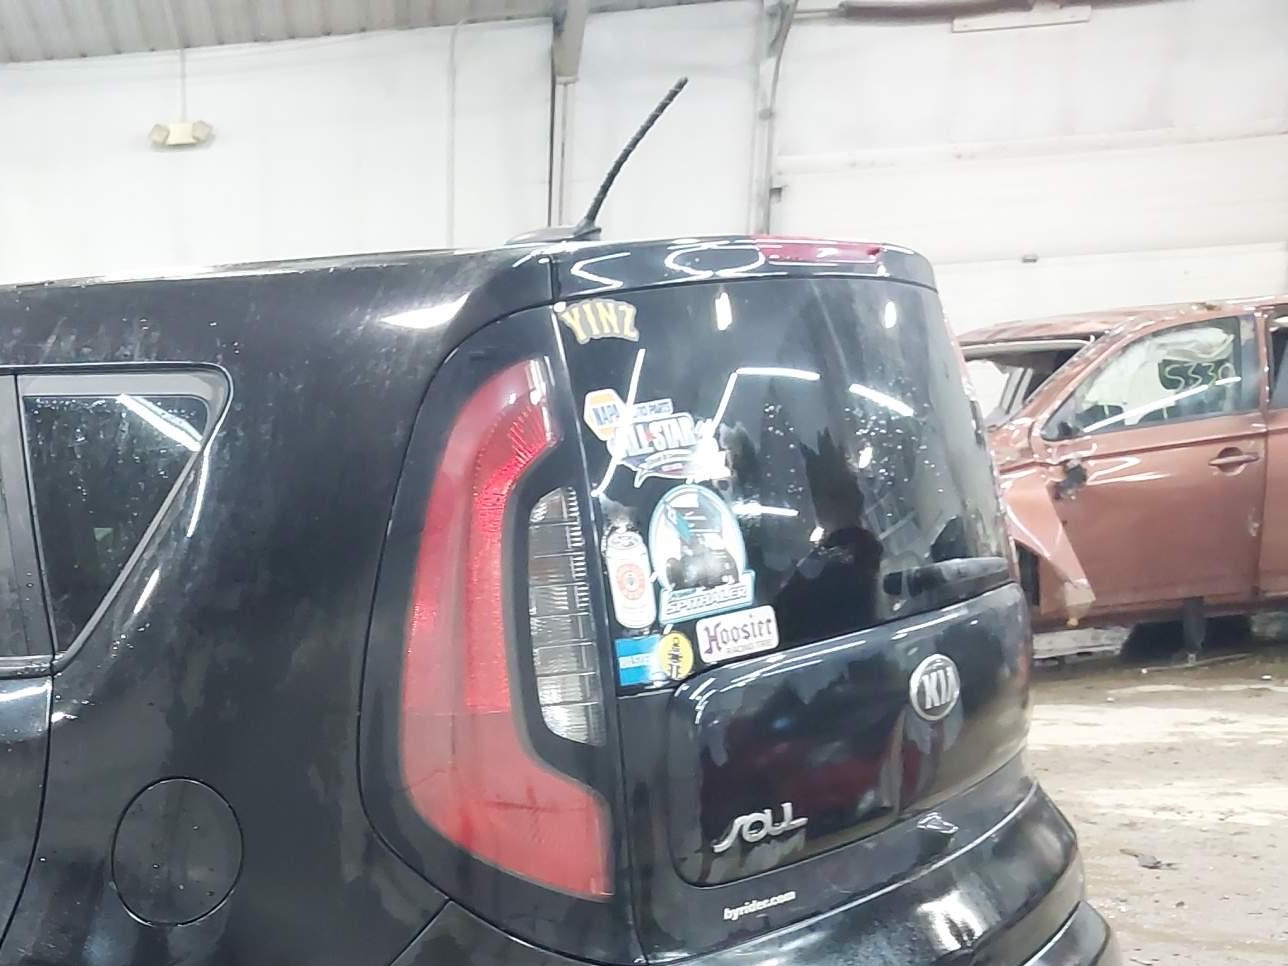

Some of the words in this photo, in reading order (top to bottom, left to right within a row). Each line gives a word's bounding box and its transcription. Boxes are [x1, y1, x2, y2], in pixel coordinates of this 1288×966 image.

[561, 300, 638, 342] YINZ
[704, 614, 773, 655] Hoosier
[712, 802, 809, 853] SOUL
